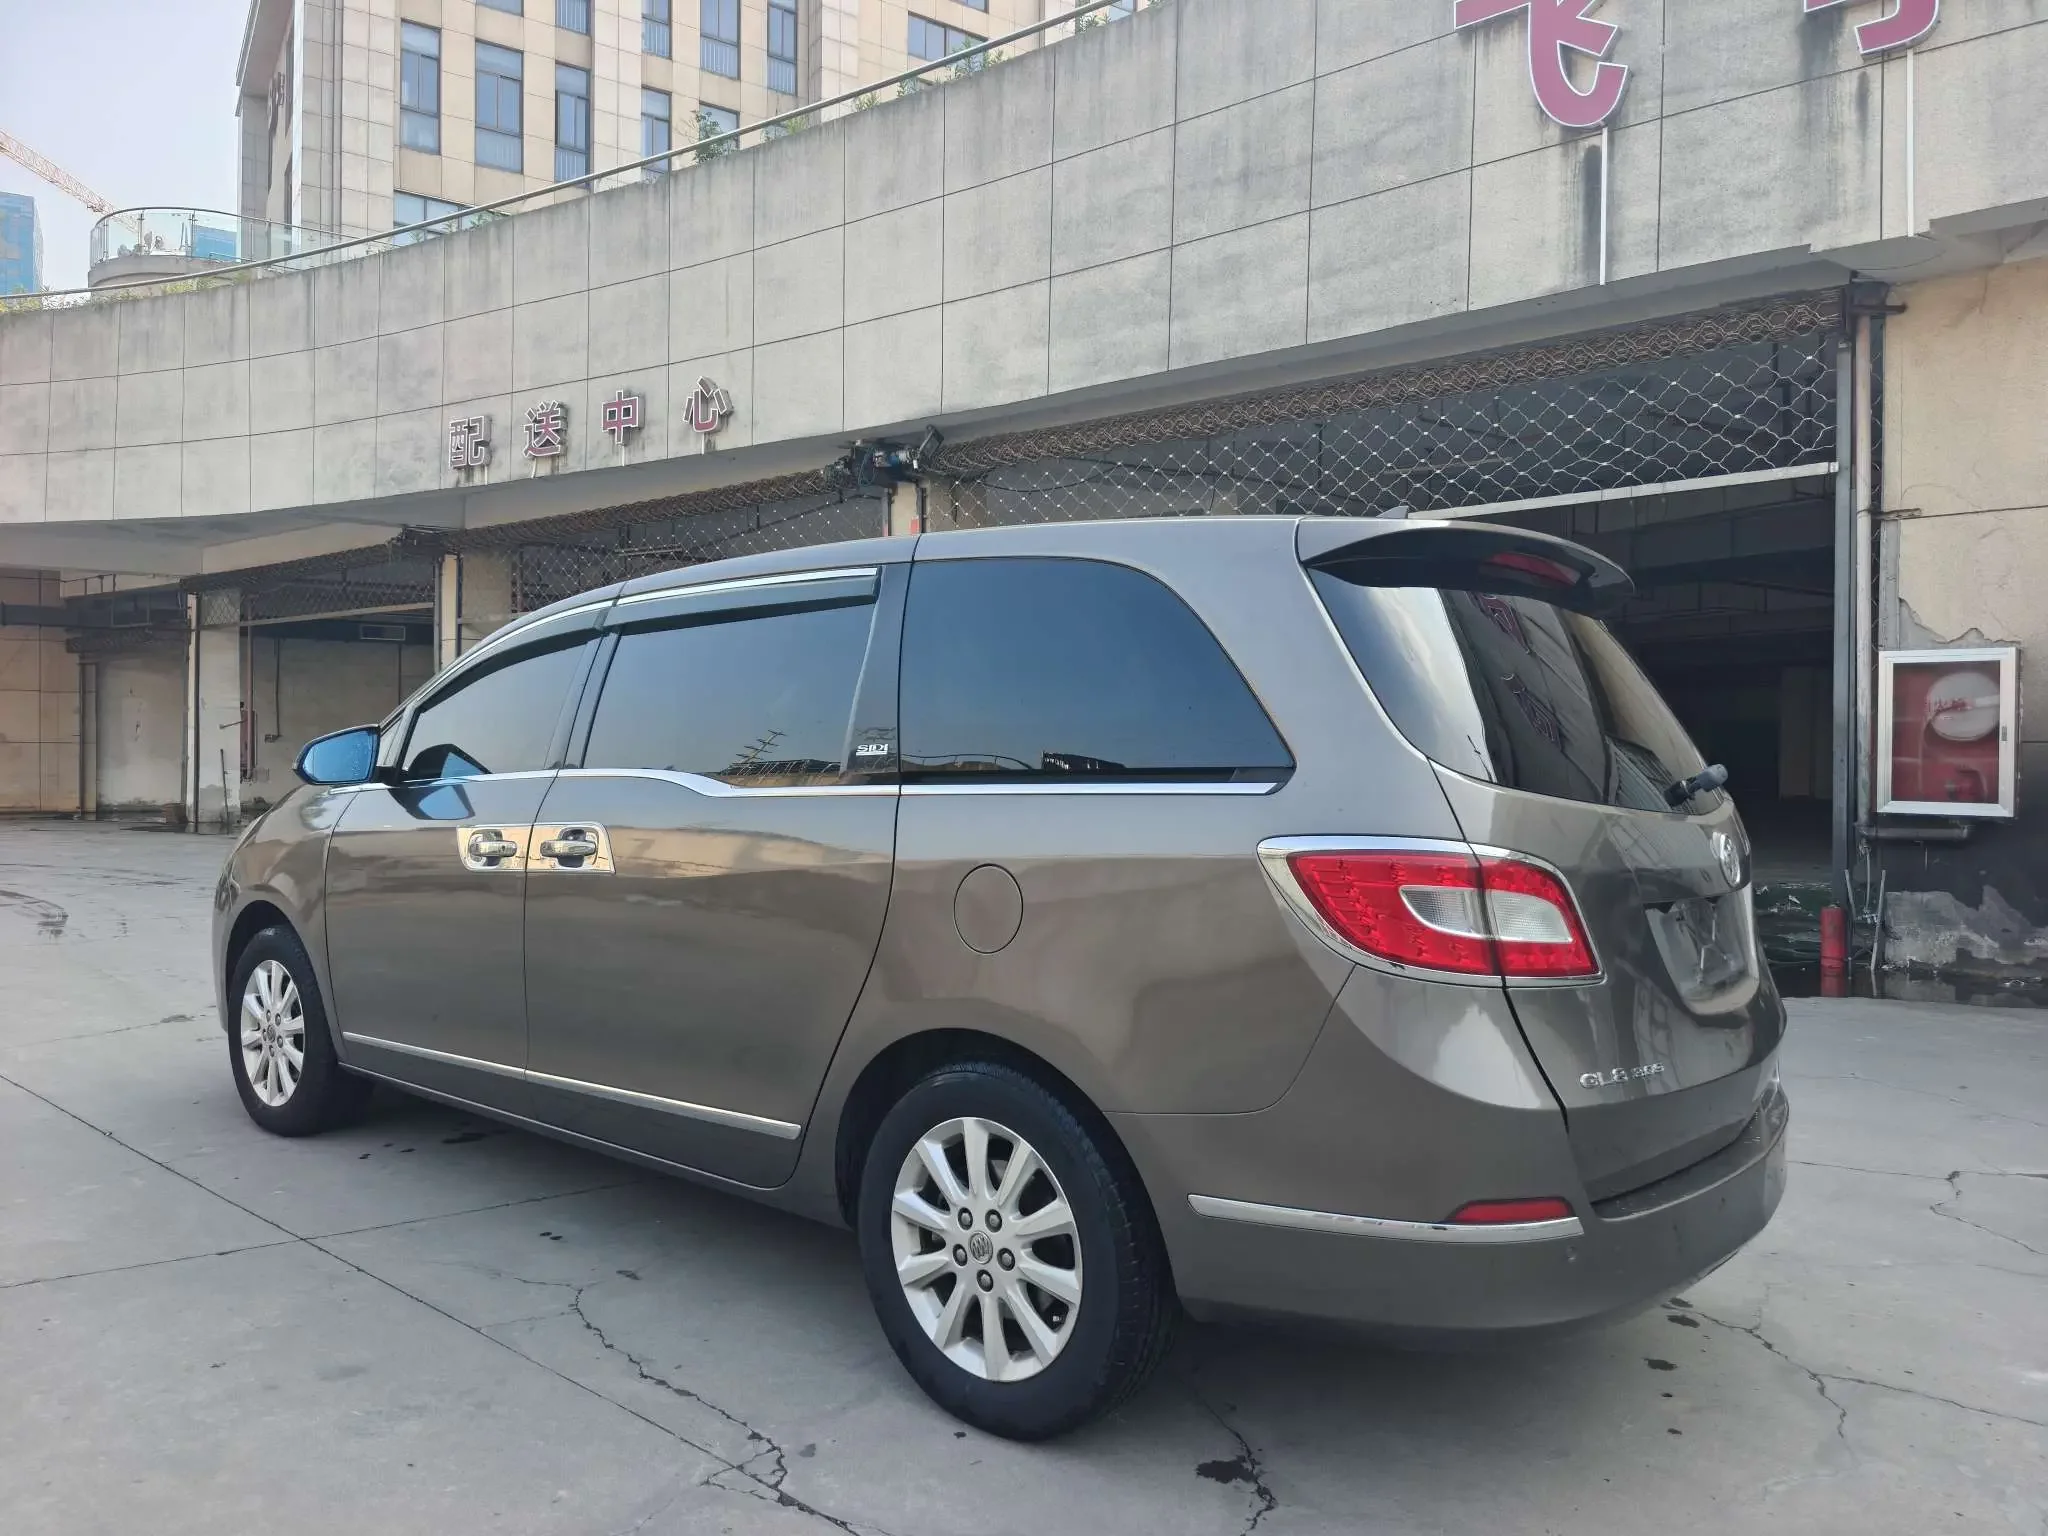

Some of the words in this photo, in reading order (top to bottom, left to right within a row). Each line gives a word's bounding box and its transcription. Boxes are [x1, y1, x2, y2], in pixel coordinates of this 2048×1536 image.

[449, 375, 731, 467] 配送中心
[1579, 1067, 1628, 1089] GL8
